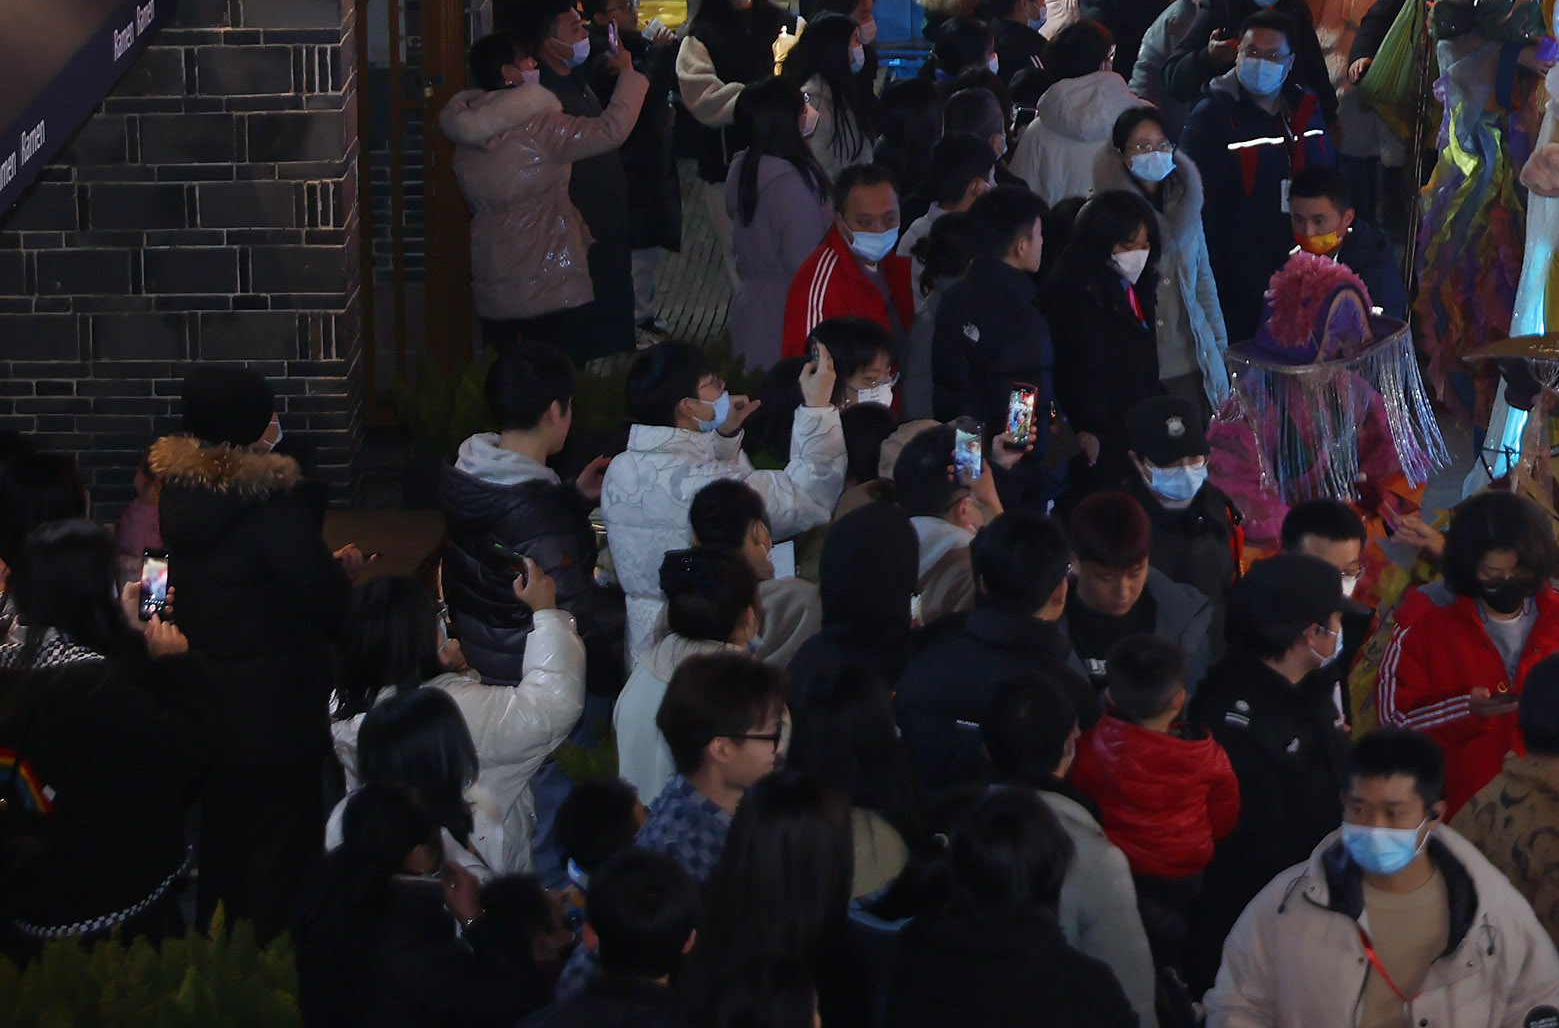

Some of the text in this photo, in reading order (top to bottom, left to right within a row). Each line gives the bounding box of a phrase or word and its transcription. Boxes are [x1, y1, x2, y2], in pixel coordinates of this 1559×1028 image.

[114, 21, 134, 61] Ramen
[0, 119, 45, 191] men Ramen
